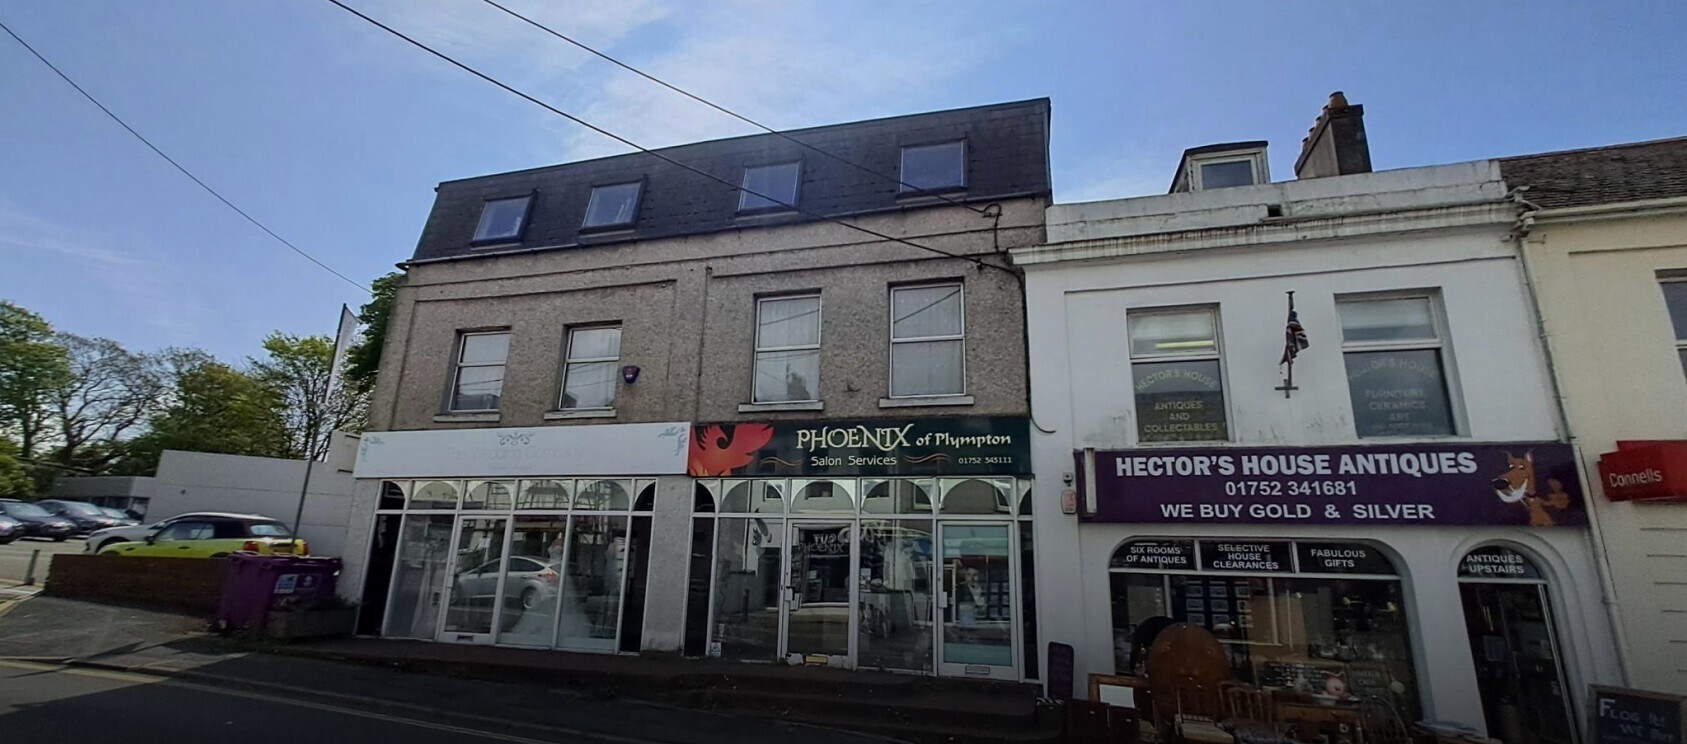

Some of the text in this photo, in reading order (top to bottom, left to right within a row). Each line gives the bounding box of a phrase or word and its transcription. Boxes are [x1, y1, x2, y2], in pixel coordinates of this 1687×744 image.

[1184, 370, 1217, 389] HOUSE
[1155, 401, 1204, 410] ANTIQUES
[1369, 400, 1427, 410] CERAMICS
[1169, 412, 1190, 420] AND
[1390, 412, 1410, 421] ART
[1144, 423, 1218, 433] COLLECTABLES
[796, 423, 1012, 452] PHOENIX of Plympton
[811, 456, 841, 466] Salon
[848, 456, 897, 466] Services
[958, 457, 981, 465] 01752
[1116, 452, 1478, 477] HECTOR'S HOUSE ANTIQUES
[1609, 468, 1662, 488] Connells
[1225, 480, 1357, 495] 01752 341681
[1160, 504, 1435, 519] WE BUY GOLD & SILVER
[1130, 546, 1181, 555] SIX ROOMS
[1218, 544, 1270, 552] SELECTIVE
[1227, 553, 1262, 561] HOUSE
[1311, 549, 1366, 558] FABULOUS
[1140, 555, 1187, 564] ANTIQUES
[1466, 554, 1523, 563] ANTIQUES
[1213, 560, 1279, 569] CLEARANCES
[1324, 559, 1355, 568] GIFTS
[1468, 565, 1524, 573] UPSTAIRS
